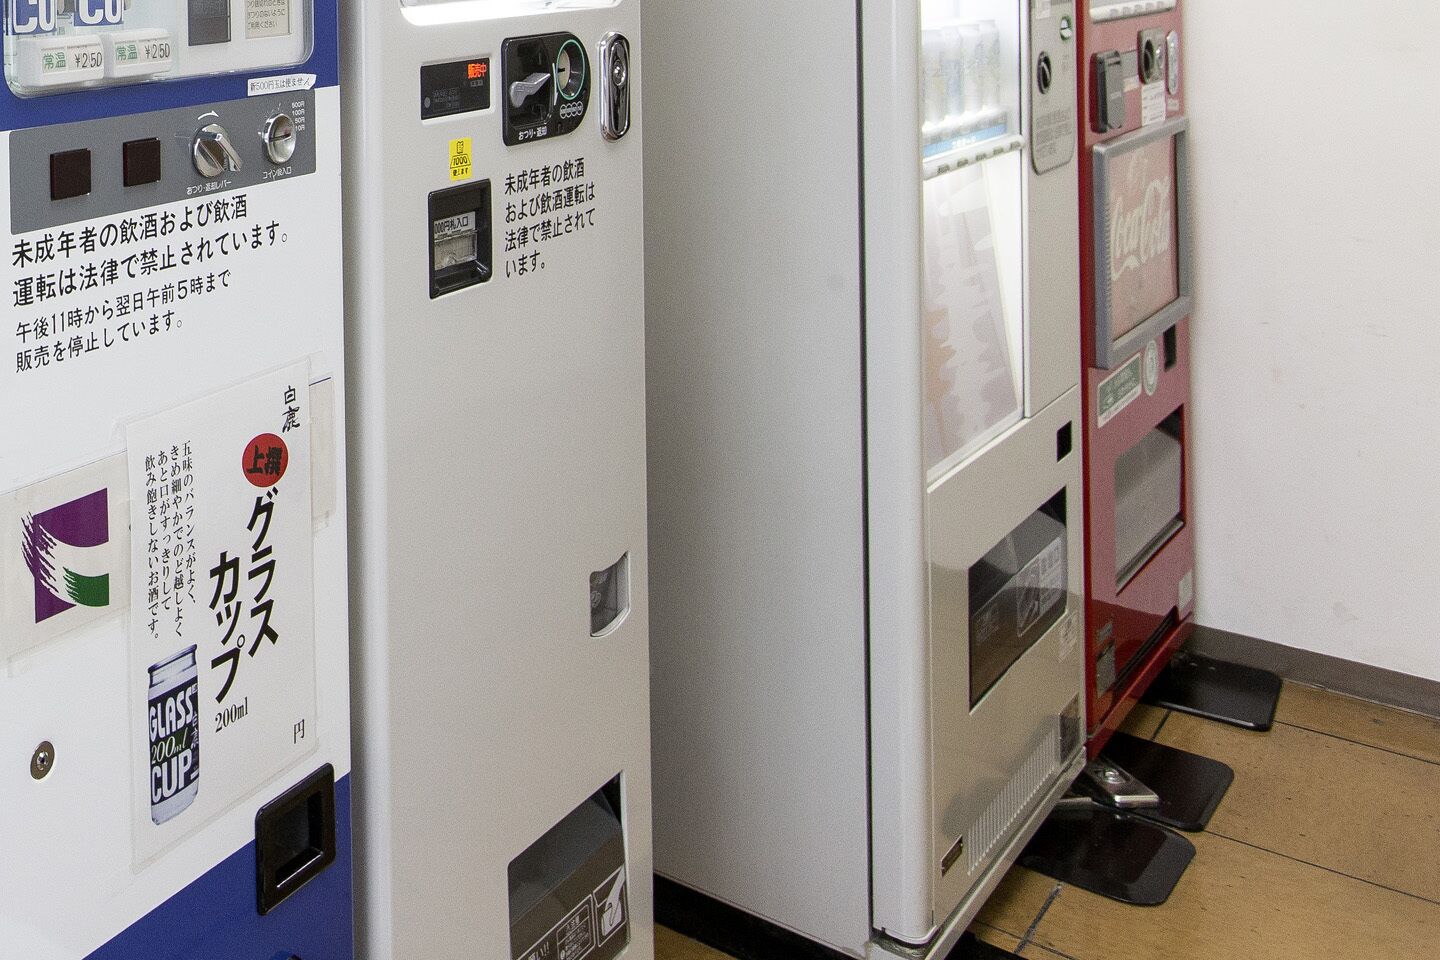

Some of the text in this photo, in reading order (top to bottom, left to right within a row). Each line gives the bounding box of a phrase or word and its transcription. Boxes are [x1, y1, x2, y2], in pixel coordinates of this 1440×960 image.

[504, 157, 585, 195] 未成年者の飲酒
[505, 181, 595, 224] および飲酒運転は
[12, 193, 248, 269] 未成年者の飲酒および飲酒
[504, 207, 596, 252] 法律で禁止されて
[13, 219, 289, 308] 運転は法律で禁止されています。
[505, 250, 546, 278] います。
[16, 269, 232, 344] 午後11時から翌日午前5時まで
[16, 309, 184, 373] 販売を停止しています。
[144, 454, 160, 640] 飲み飽きしないお酒です。
[157, 450, 172, 611] あと口がすっきりして
[169, 444, 184, 638] きめ細やかでのど越しよく
[181, 440, 197, 606] 五味のバランスがよく、
[247, 486, 279, 657] グラス
[209, 550, 246, 704] カップ
[149, 686, 194, 742] GLASS
[151, 727, 189, 765] 200ml
[214, 696, 249, 733] 200ml
[293, 718, 305, 744] 円
[152, 748, 192, 803] CUP
